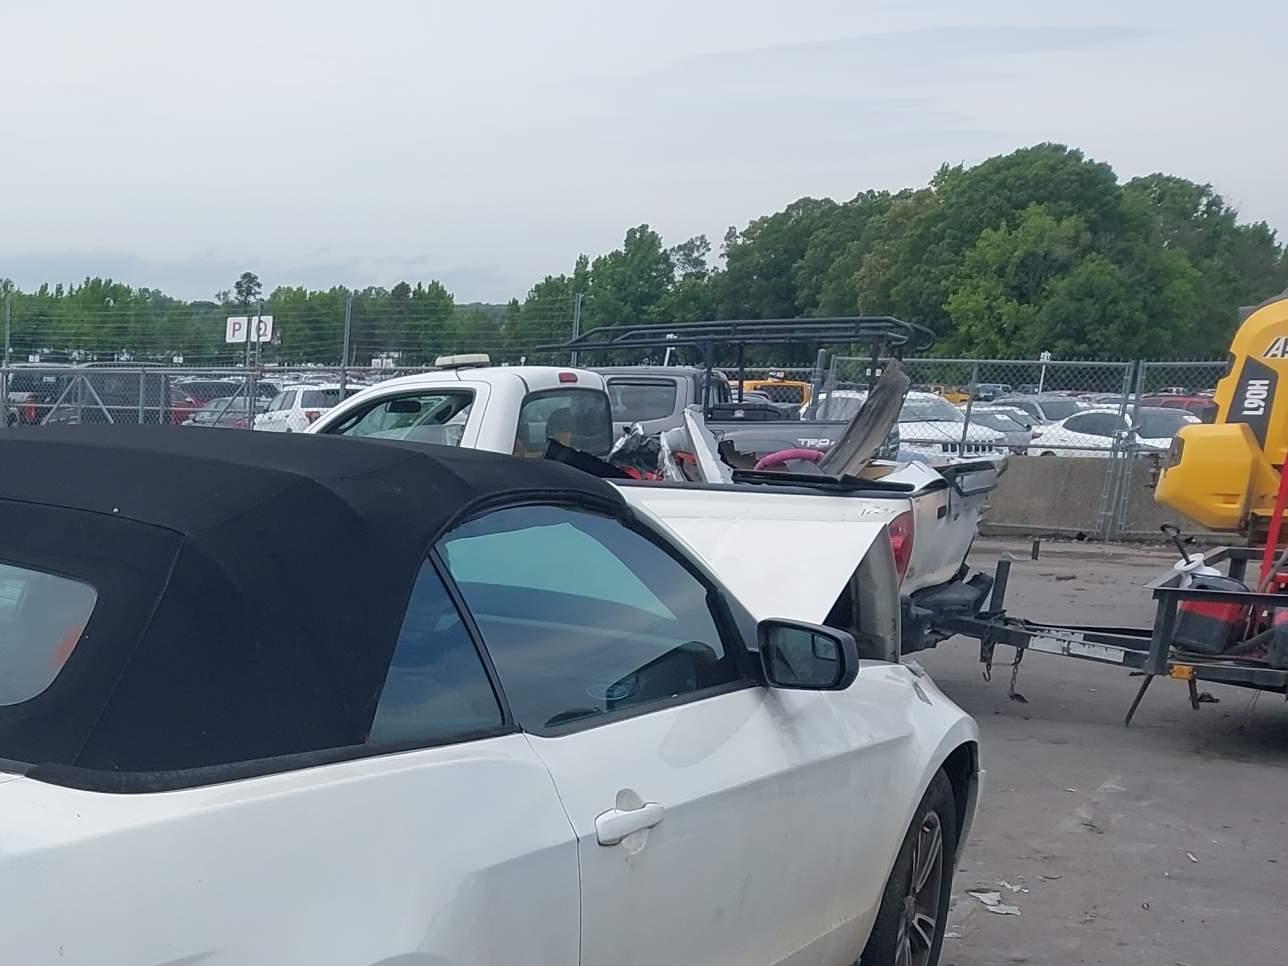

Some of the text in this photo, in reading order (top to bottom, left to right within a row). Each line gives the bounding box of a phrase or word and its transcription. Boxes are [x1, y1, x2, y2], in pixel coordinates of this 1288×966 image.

[231, 321, 242, 338] P
[256, 320, 268, 337] Q
[1241, 379, 1270, 416] L90H
